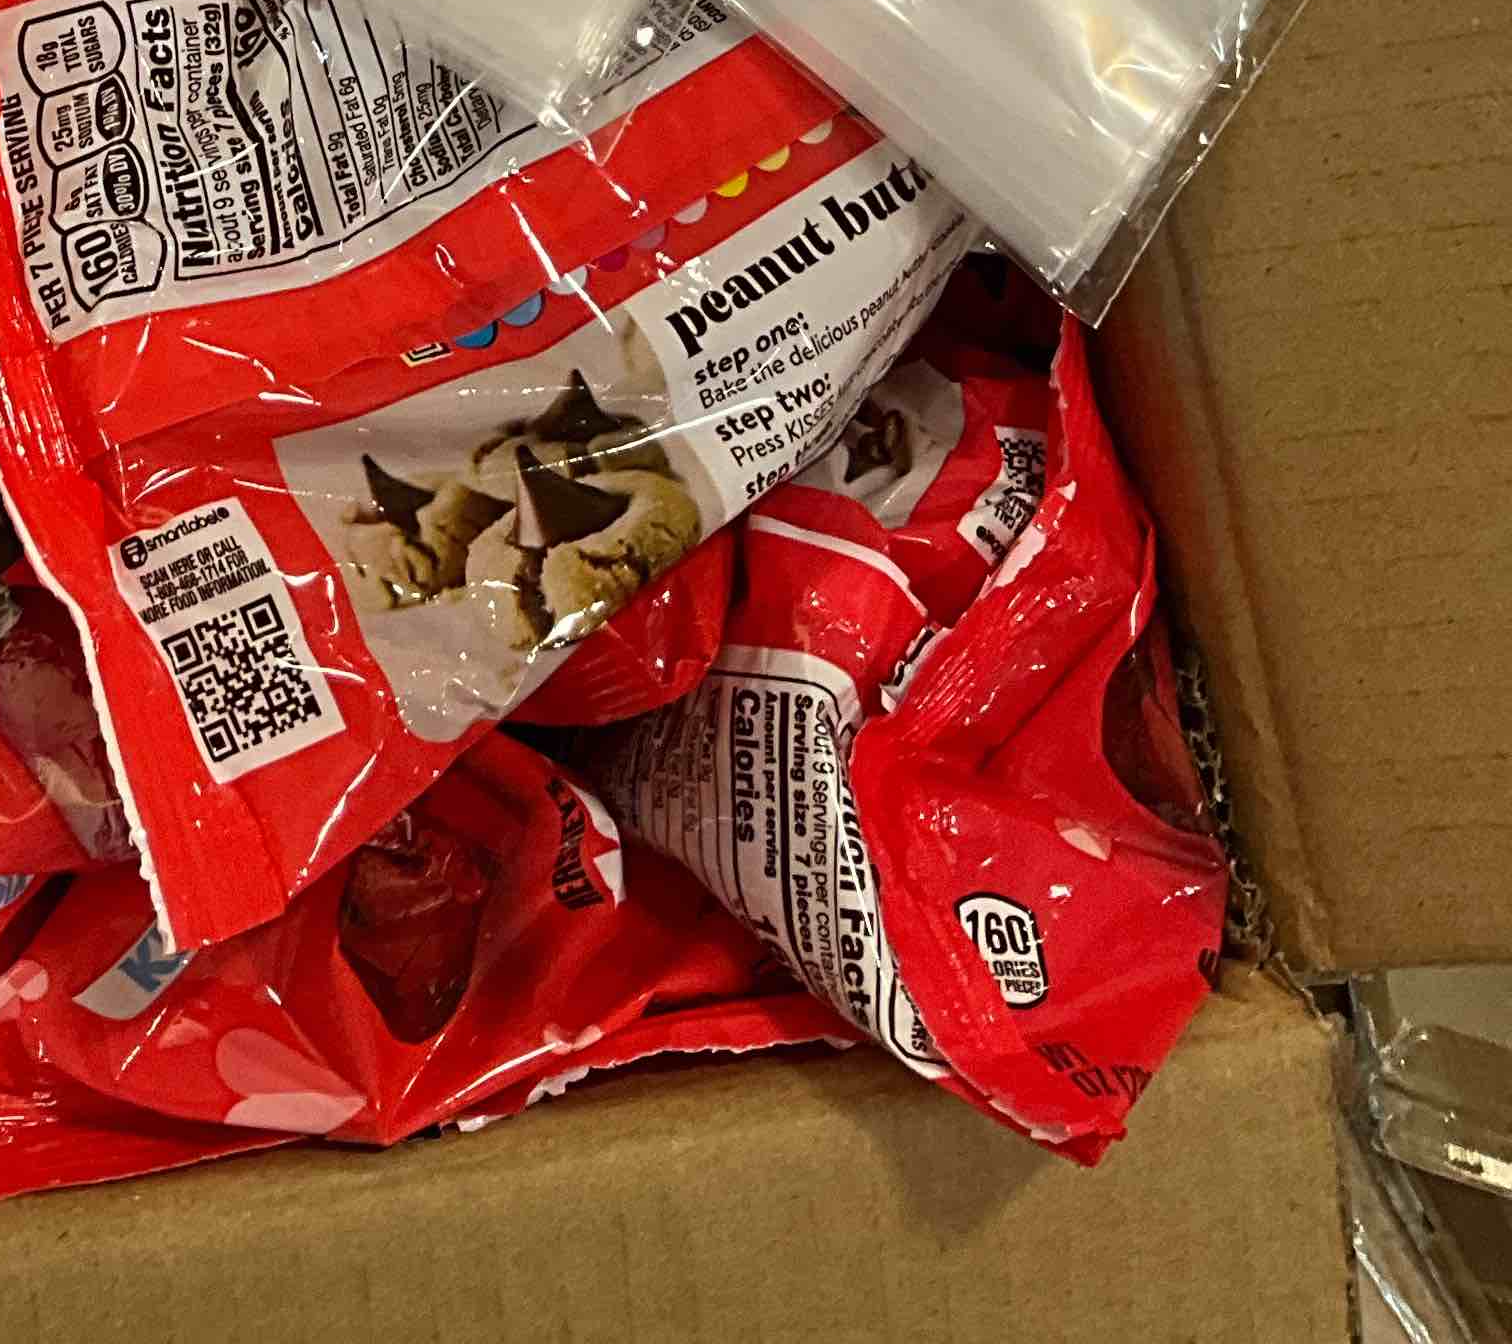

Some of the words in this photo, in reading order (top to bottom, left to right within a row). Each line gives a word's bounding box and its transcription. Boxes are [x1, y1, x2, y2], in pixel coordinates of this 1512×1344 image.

[59, 27, 81, 72] TOTAL
[80, 15, 105, 73] SUGARS
[142, 7, 174, 111] Facts
[183, 18, 201, 103] container
[198, 4, 221, 56] (32g)
[0, 93, 37, 191] SERVING
[73, 93, 93, 148] SODIUM
[158, 124, 214, 268] Nutrition
[32, 260, 54, 279] 7
[75, 229, 119, 304] 160
[115, 223, 138, 283] CALORIES
[39, 274, 70, 329] PER
[666, 217, 835, 358] peanut
[695, 346, 749, 385] step
[756, 312, 810, 352] one:
[700, 375, 748, 409] Bake
[750, 359, 785, 385] the
[790, 317, 858, 367] delicious
[715, 404, 775, 441] step
[777, 373, 832, 410] two:
[731, 432, 784, 467] Press
[140, 566, 169, 589] SCAN
[168, 554, 197, 581] HERE
[213, 536, 241, 556] CALL
[762, 690, 778, 766] Amount
[791, 693, 813, 784] Serving
[734, 688, 760, 843] Calories
[764, 769, 776, 804] per
[764, 807, 777, 880] serving
[793, 789, 806, 838] size
[796, 852, 811, 868] 7
[792, 874, 812, 953] pieces
[966, 909, 1031, 955] 160
